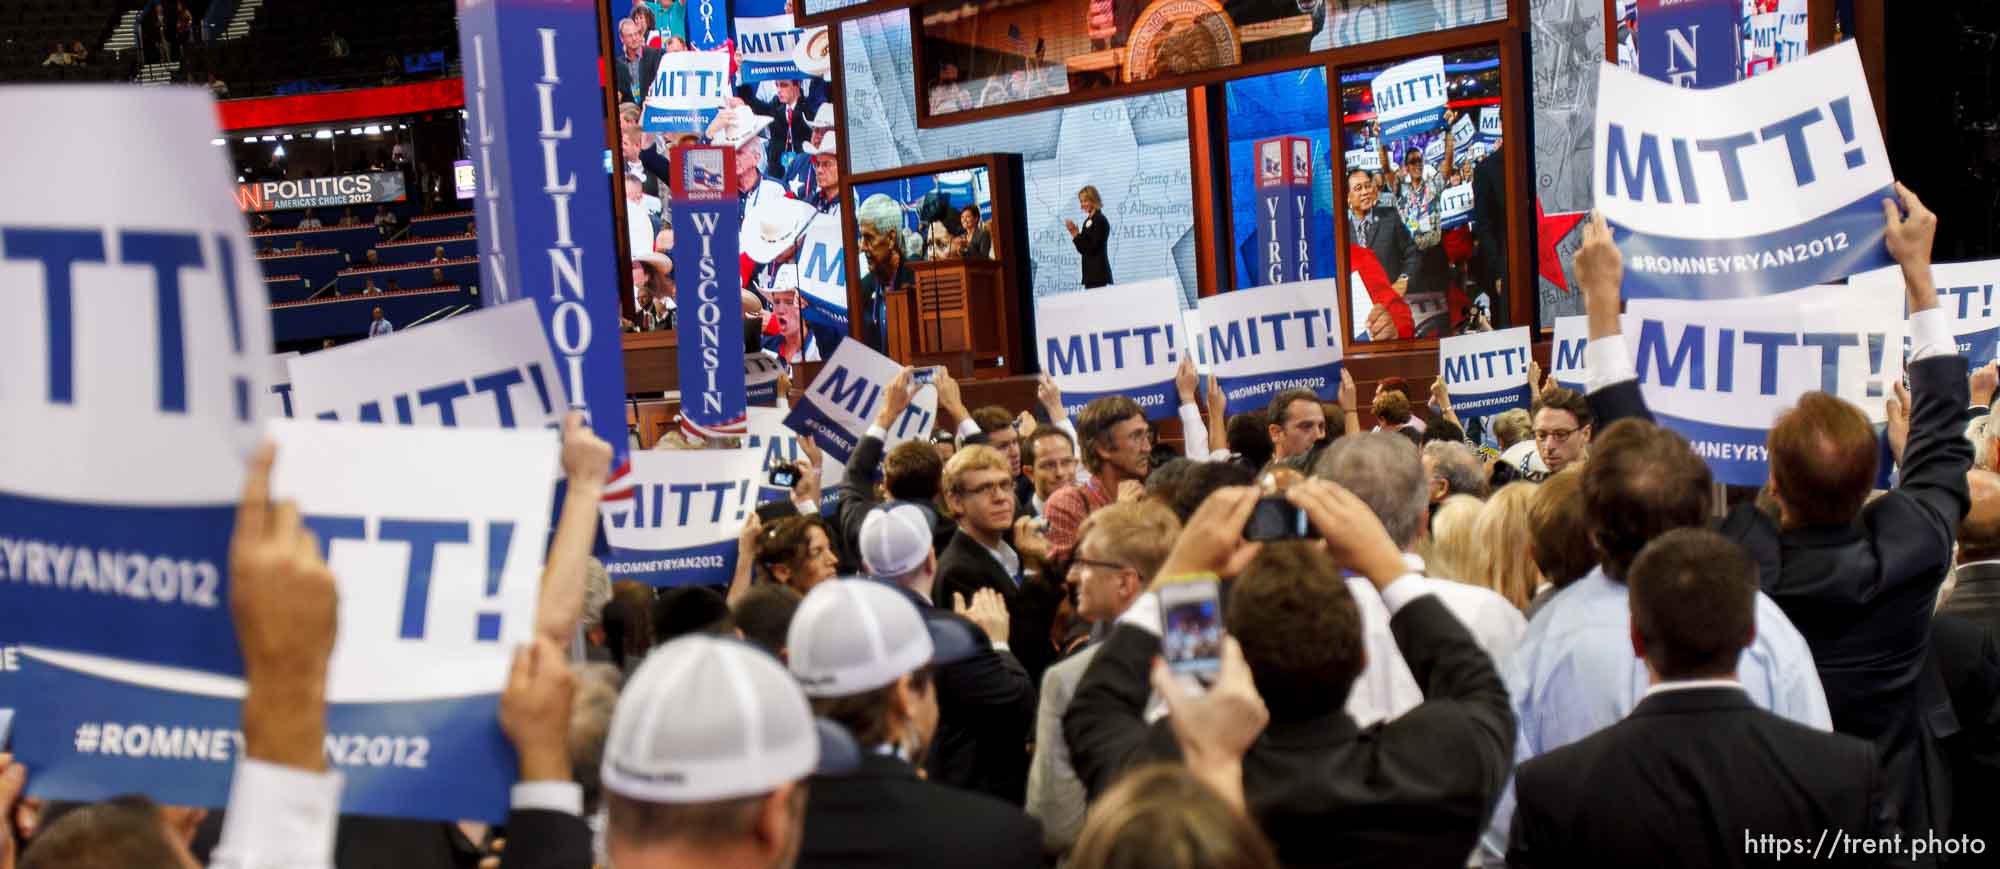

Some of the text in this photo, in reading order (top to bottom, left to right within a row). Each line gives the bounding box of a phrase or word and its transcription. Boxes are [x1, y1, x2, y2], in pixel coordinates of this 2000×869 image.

[699, 0, 715, 43] OTA
[1376, 73, 1443, 113] MITT!
[1606, 96, 1866, 205] MITT!
[264, 174, 372, 201] POLITICS
[274, 193, 373, 210] AMERICA'S CHOICE 2012
[535, 28, 593, 425] ILLINOI
[1632, 231, 1849, 276] #ROMNEYRYAN2012
[690, 211, 723, 415] WISCONSIN
[1046, 324, 1177, 377] MITT!
[1210, 308, 1335, 365] MITT!
[1636, 318, 1887, 398] MITT!
[1444, 346, 1528, 385] MITT!
[1228, 377, 1326, 400] #ROMNEYRYAN2012
[606, 555, 724, 574] #ROMNEYRYAN2012
